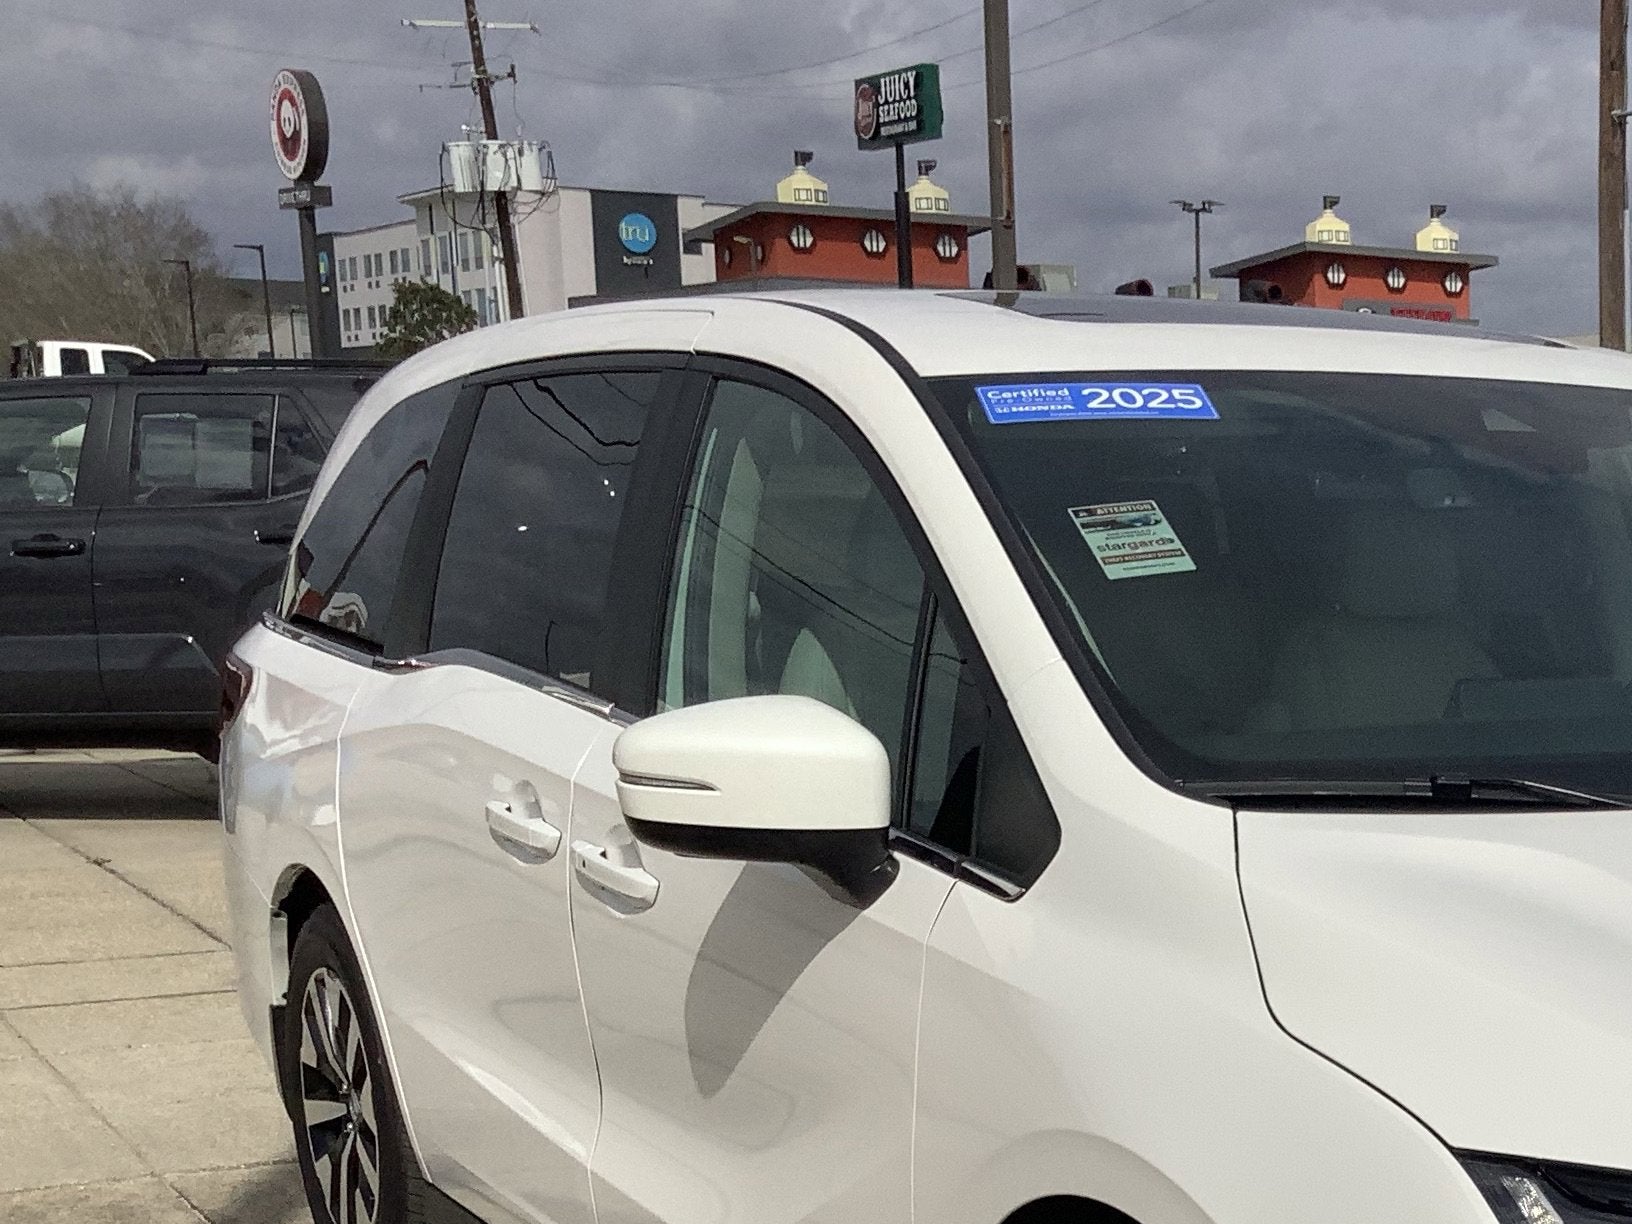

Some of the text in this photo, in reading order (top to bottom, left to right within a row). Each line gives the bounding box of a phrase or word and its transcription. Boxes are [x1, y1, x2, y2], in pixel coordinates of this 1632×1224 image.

[878, 70, 916, 105] JUICY
[879, 99, 918, 123] SEAFOOD
[620, 221, 649, 243] tru
[987, 387, 1204, 410] Certified 2025
[1096, 503, 1152, 515] ATTENTION
